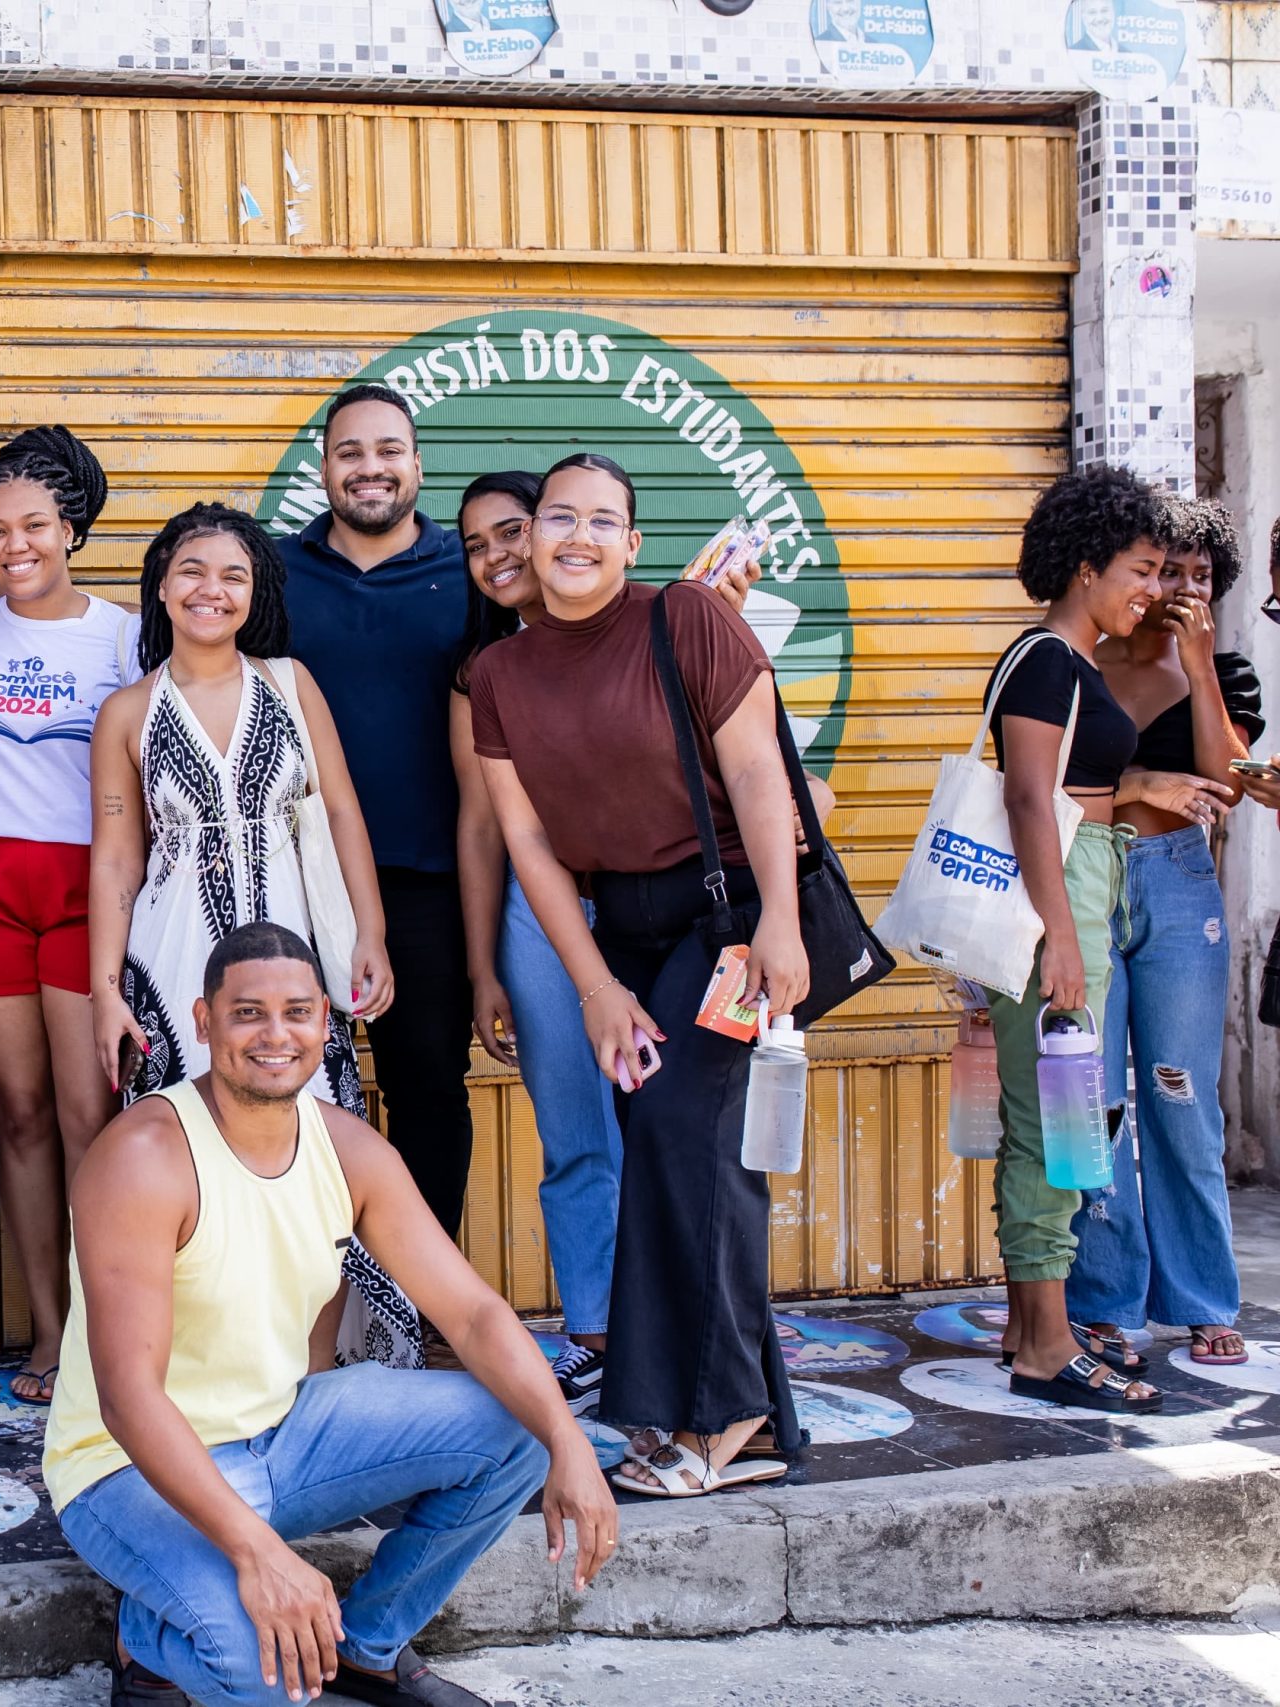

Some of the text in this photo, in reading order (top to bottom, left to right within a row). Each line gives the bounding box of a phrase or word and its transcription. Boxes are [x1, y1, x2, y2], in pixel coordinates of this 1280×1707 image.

[463, 38, 534, 53] Dr.Fábio
[1220, 188, 1272, 205] 55610
[520, 328, 618, 383] DOS
[621, 354, 821, 584] ESTUDANTES
[949, 839, 977, 860] COM
[981, 850, 1018, 874] VOCÊ
[940, 857, 1010, 892] enem
